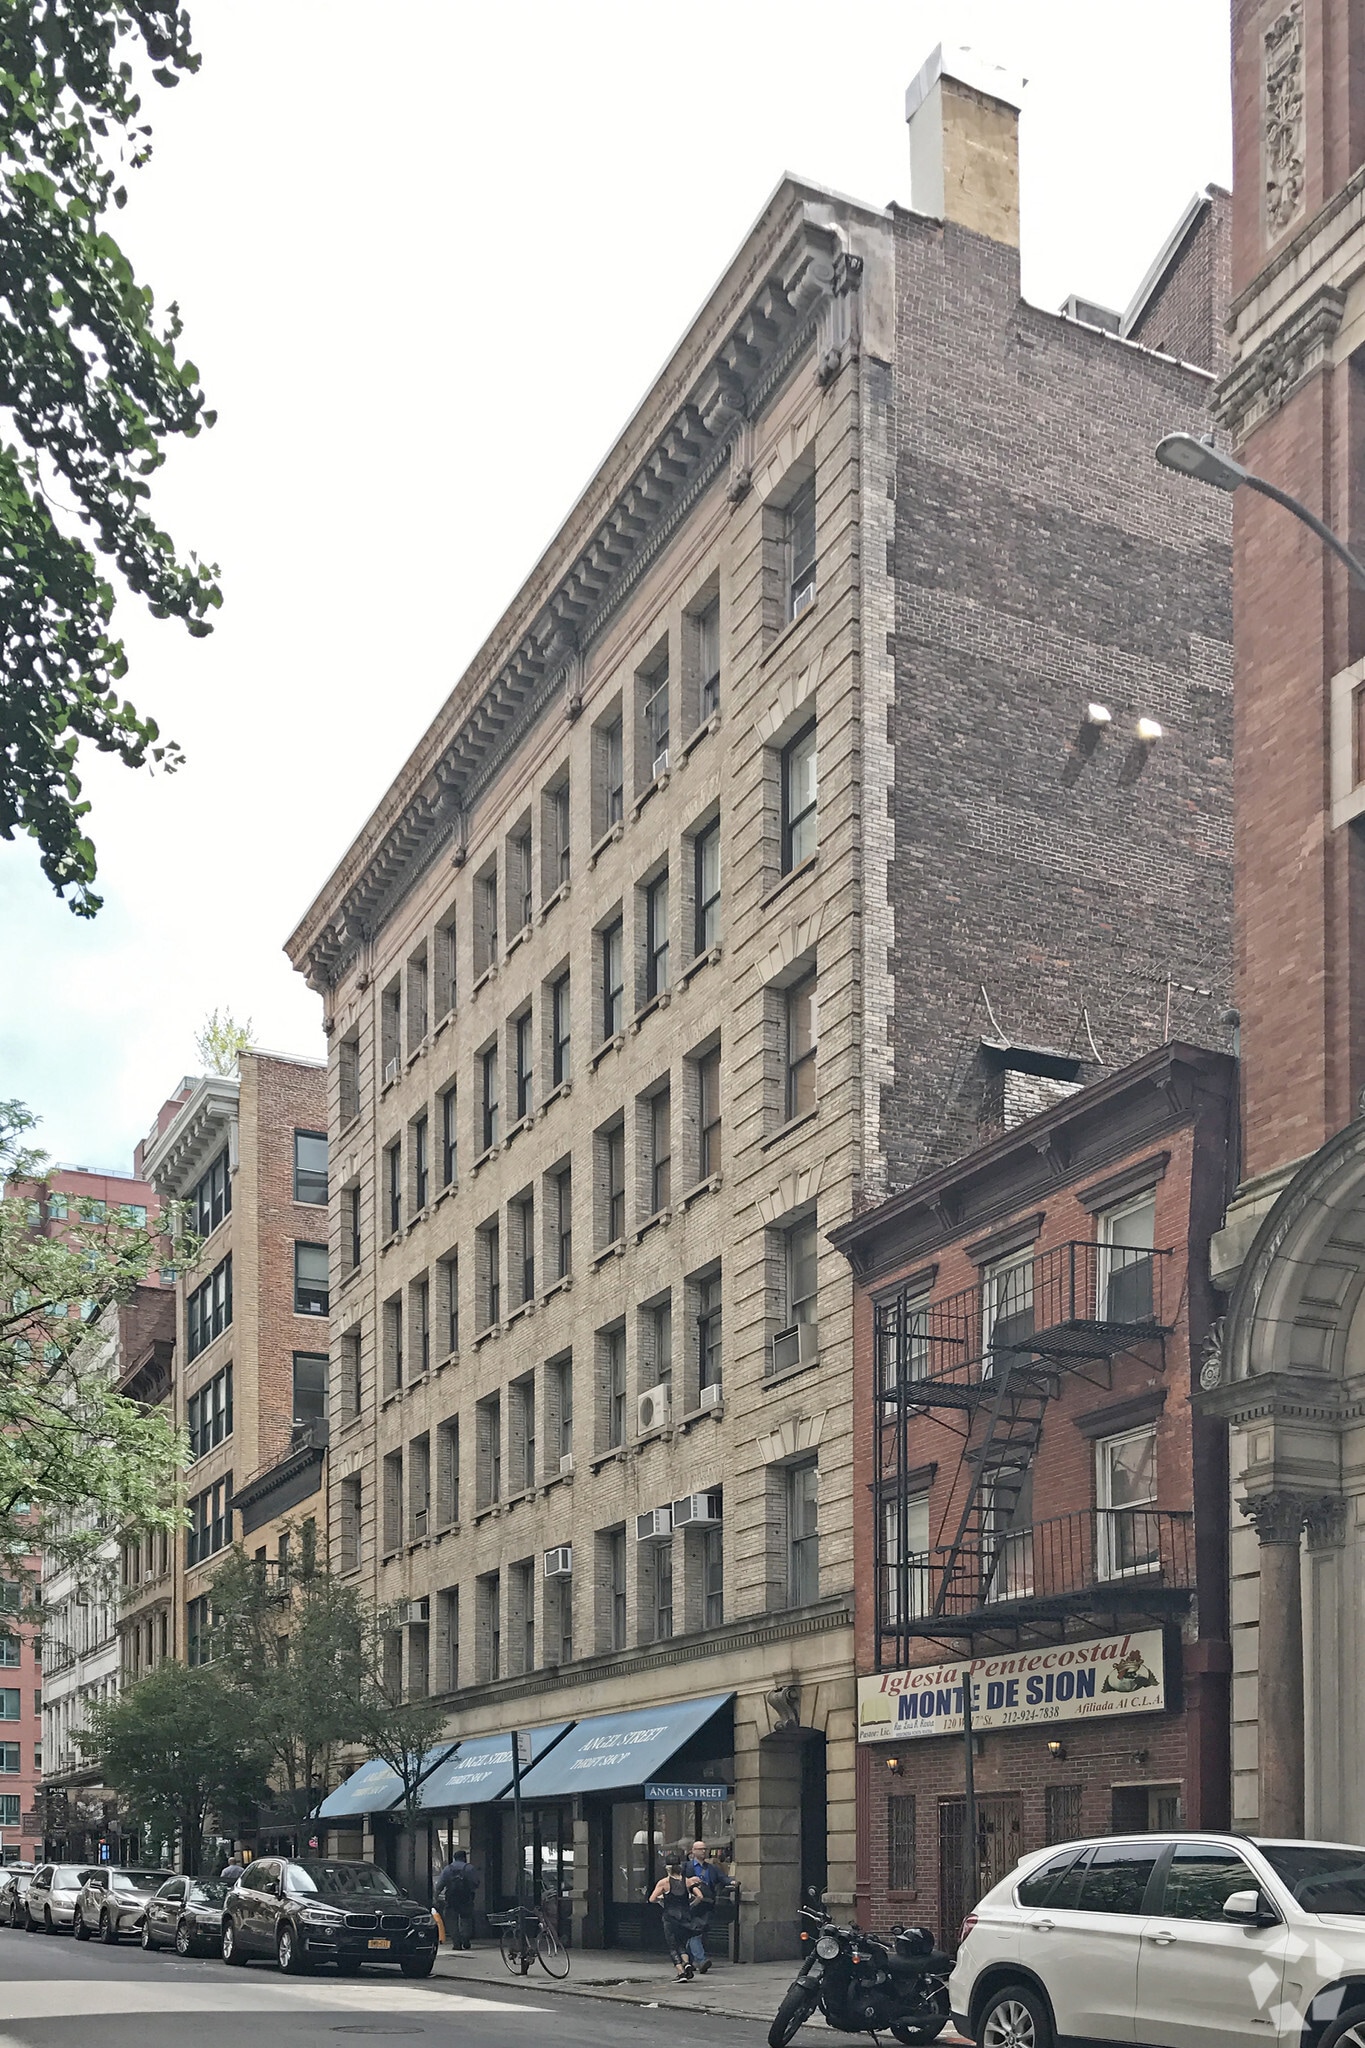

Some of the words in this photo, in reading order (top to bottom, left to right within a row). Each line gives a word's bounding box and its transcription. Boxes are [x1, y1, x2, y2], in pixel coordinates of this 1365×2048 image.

[878, 1664, 958, 1697] Iglesia
[968, 1634, 1131, 1678] Pentecostal
[898, 1683, 980, 1721] MONTE
[986, 1679, 1020, 1710] DE
[1025, 1667, 1097, 1706] SION
[1074, 1701, 1114, 1715] Afiliada
[1115, 1698, 1128, 1709] Al
[1131, 1694, 1163, 1707] C.L.A.
[942, 1719, 957, 1730] 120
[1002, 1706, 1060, 1724] 212-924-7838
[578, 1733, 623, 1752] ANGEL
[616, 1726, 669, 1746] STREET
[649, 1787, 685, 1797] ANGEL
[687, 1788, 723, 1798] STREET
